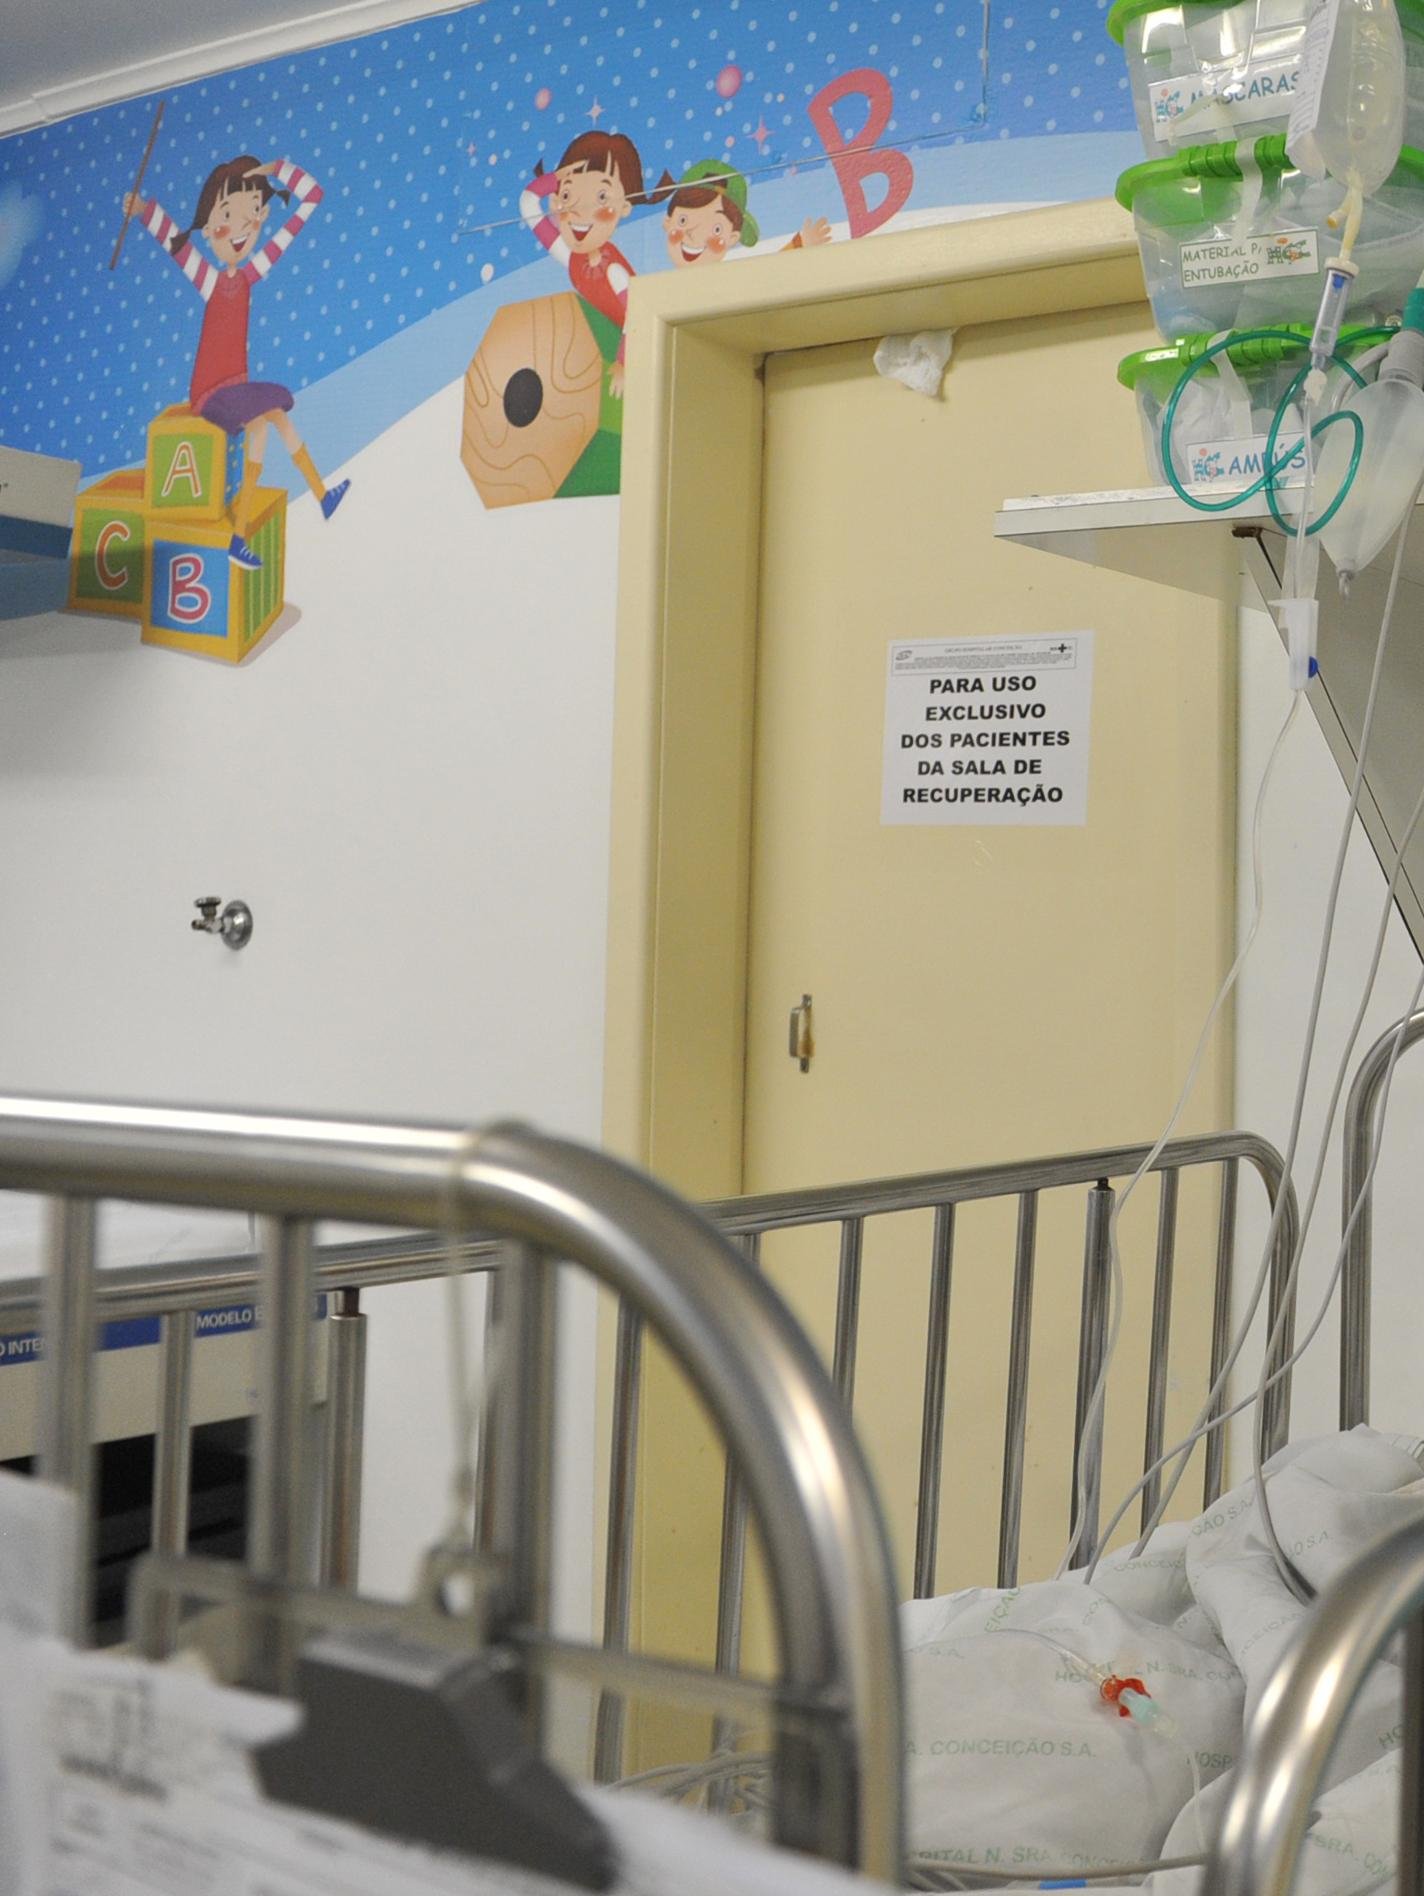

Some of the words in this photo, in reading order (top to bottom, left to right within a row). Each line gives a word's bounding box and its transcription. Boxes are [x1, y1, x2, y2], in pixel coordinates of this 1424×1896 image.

[807, 66, 914, 240] B
[1184, 260, 1259, 282] ENTUBAÇÃO
[161, 442, 202, 498] A
[95, 521, 130, 589] C
[167, 553, 211, 624] B
[930, 677, 984, 694] PARA
[992, 676, 1037, 692] USO
[925, 703, 1046, 721] EXCLUSIVO
[901, 733, 943, 749] DOS
[950, 731, 1070, 748] PACIENTES
[917, 761, 944, 775] DA
[951, 760, 1006, 775] SALA
[1014, 759, 1042, 774] DE
[903, 784, 1063, 807] RECUPERAÇÃO
[195, 1308, 252, 1329] MODELO
[930, 1736, 1055, 1758] CONCEIÇÃO
